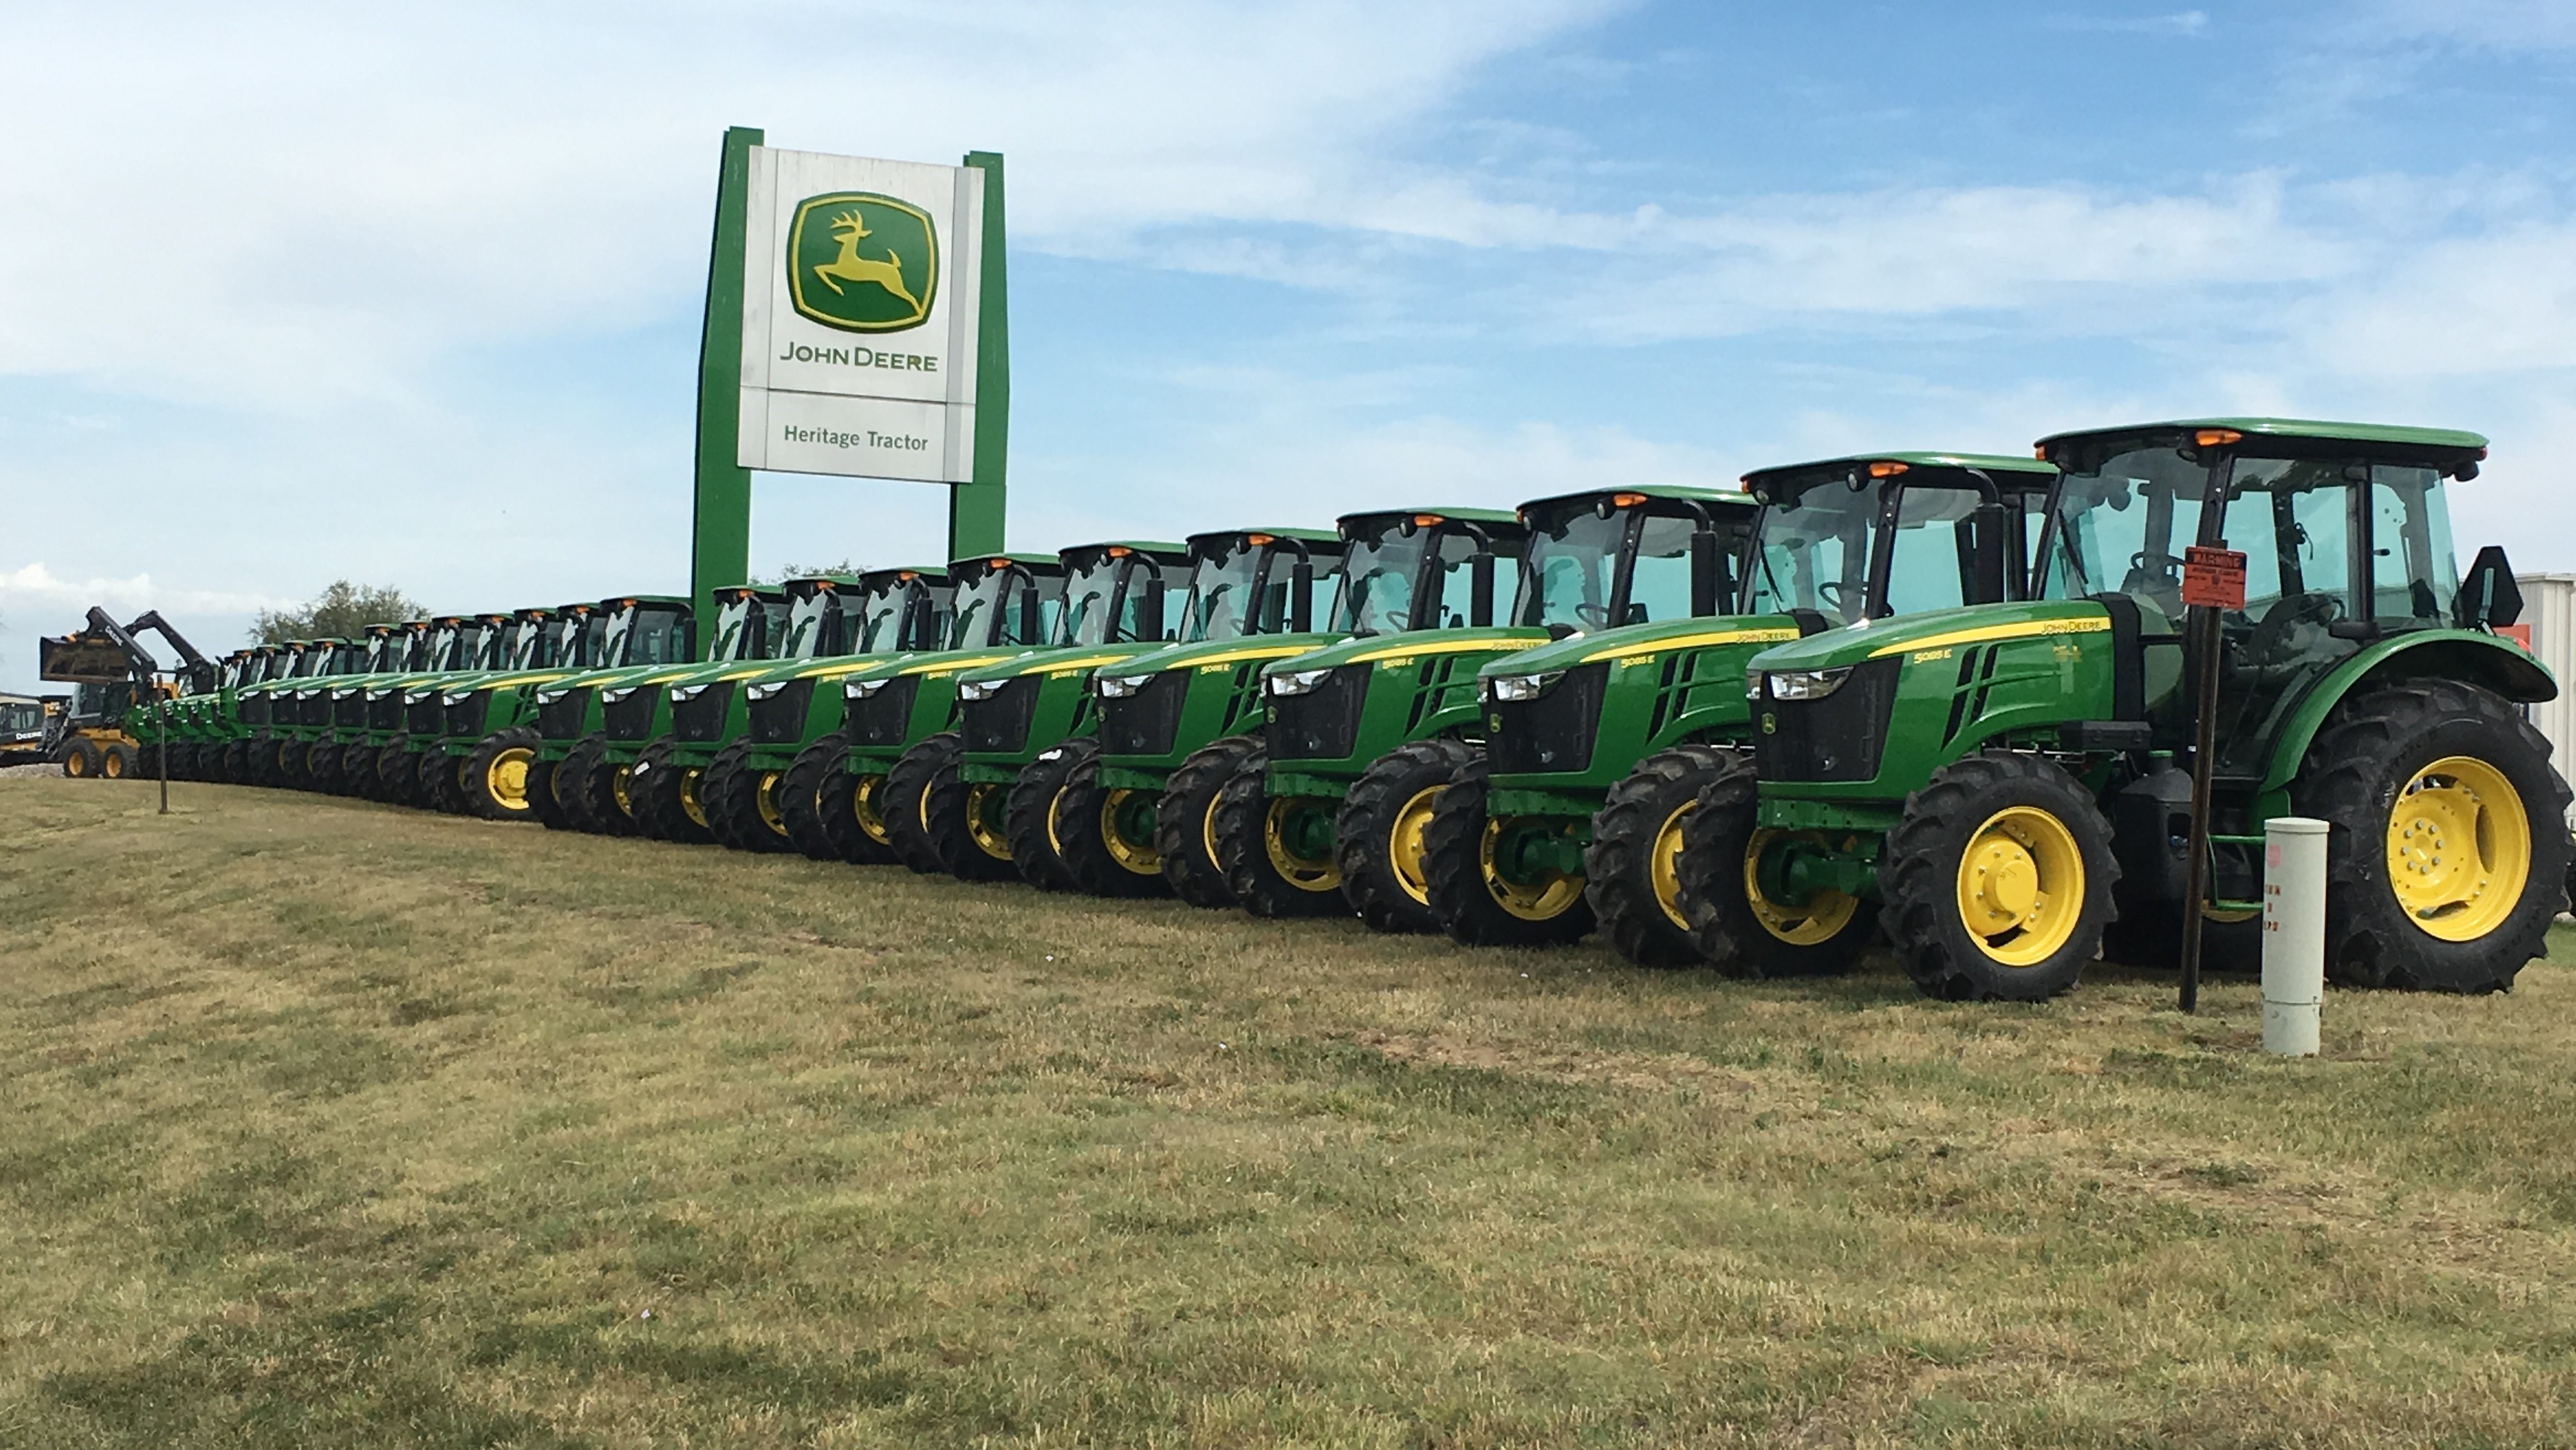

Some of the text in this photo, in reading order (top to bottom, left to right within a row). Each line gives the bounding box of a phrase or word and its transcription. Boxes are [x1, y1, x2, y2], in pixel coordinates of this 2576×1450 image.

[780, 342, 938, 372] JOHN DEERE
[785, 425, 928, 451] Heritage Tractor
[2042, 620, 2102, 634] JOHN DEERE
[1736, 631, 1791, 643] JOHN DEERE
[16, 731, 42, 740] DEERE
